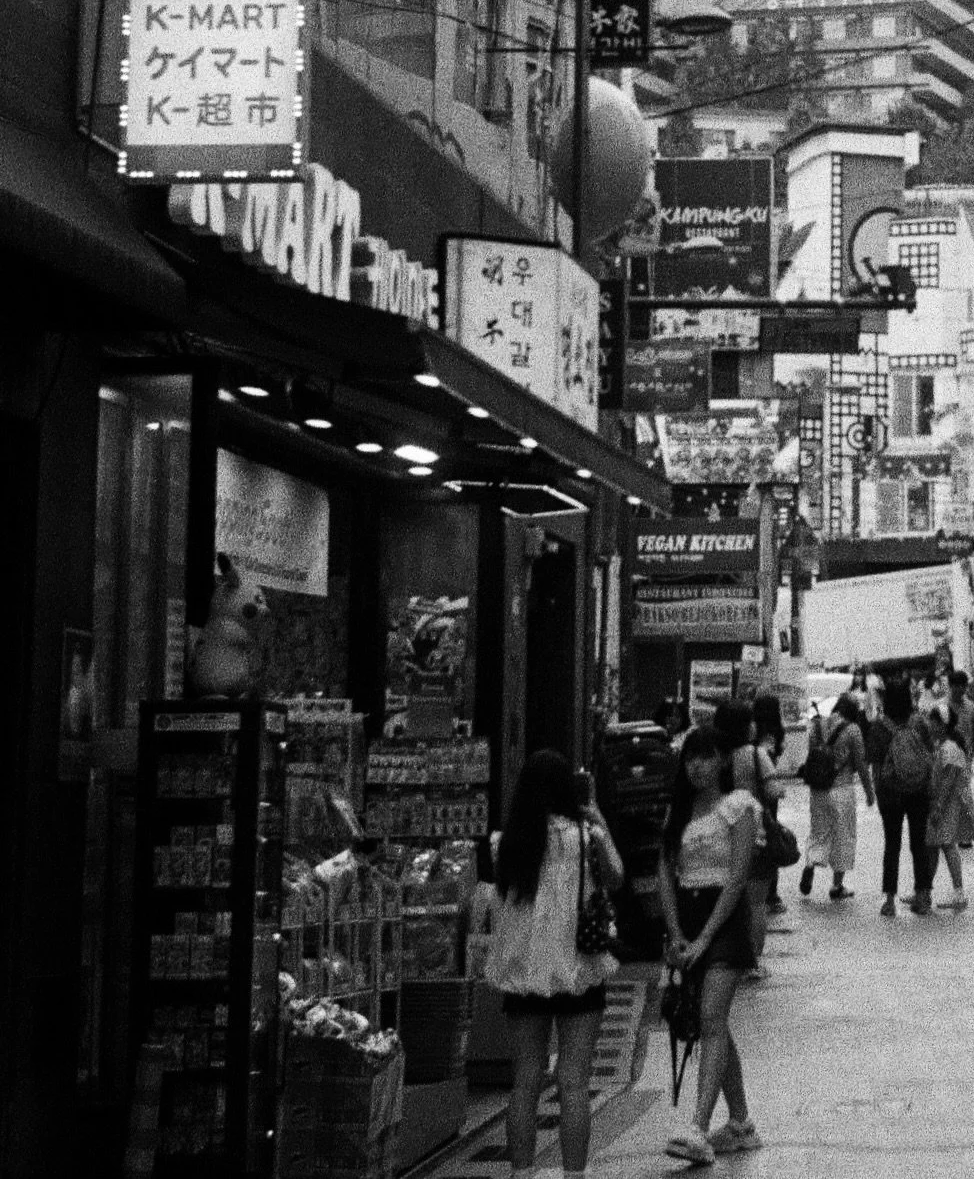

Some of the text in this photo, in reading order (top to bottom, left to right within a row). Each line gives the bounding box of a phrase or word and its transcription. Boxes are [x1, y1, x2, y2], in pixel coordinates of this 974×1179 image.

[145, 4, 287, 31] K-MART
[145, 46, 286, 81] ケイマート
[509, 256, 535, 393] 우대갈
[637, 533, 756, 552] VEGAN KITCHEN
